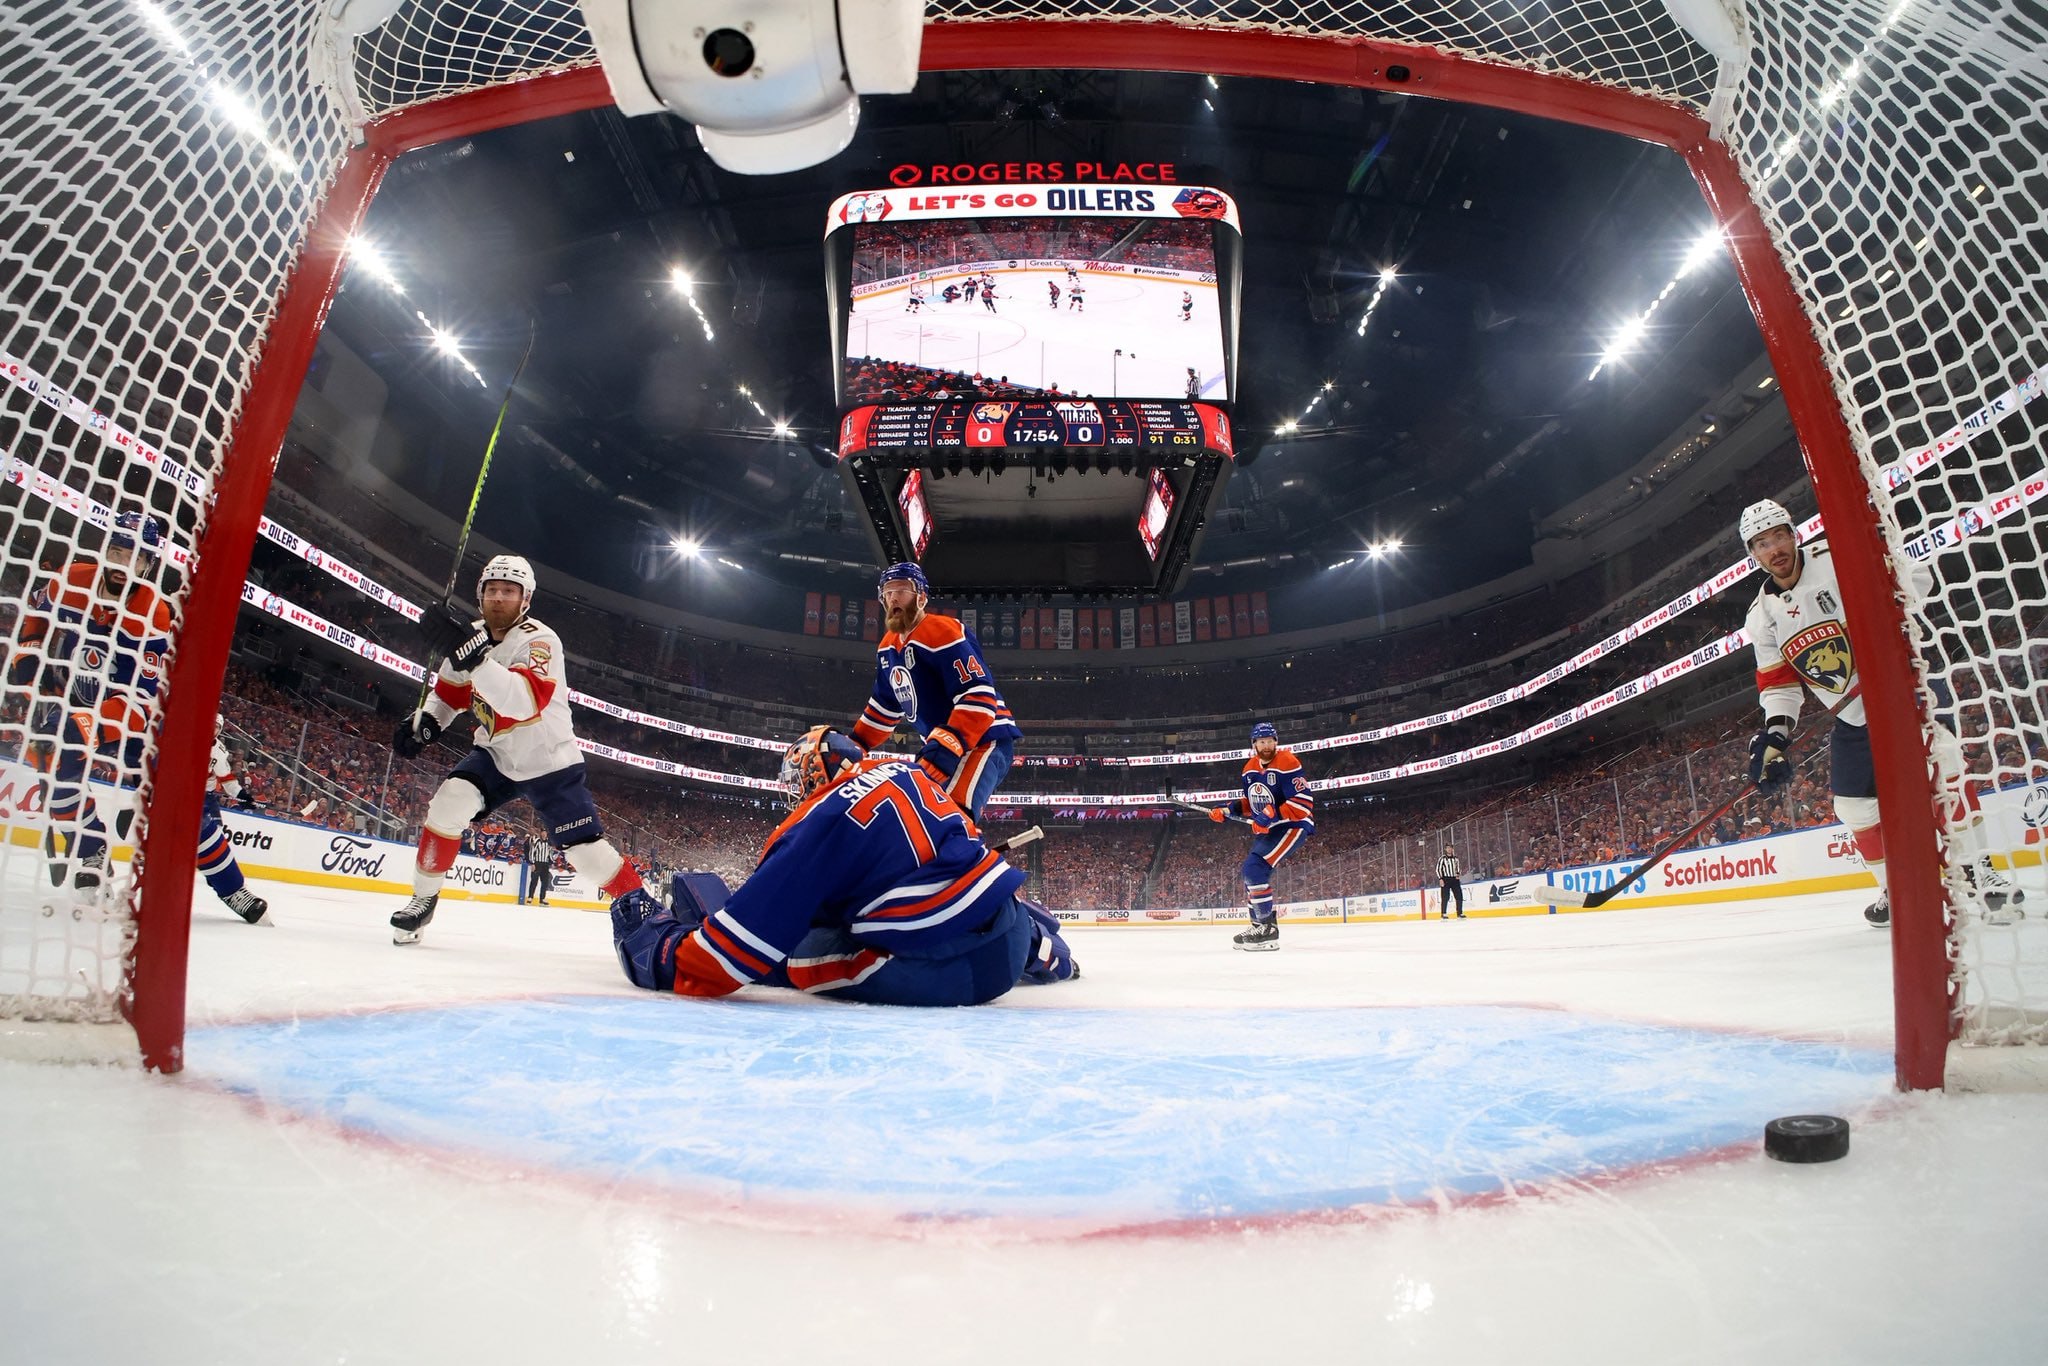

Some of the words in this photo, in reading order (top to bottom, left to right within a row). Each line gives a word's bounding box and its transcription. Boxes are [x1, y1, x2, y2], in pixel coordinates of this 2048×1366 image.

[932, 163, 1064, 182] ROGERS
[1076, 163, 1176, 180] PLACE
[909, 194, 986, 210] LET'S
[994, 194, 1037, 208] GO
[1047, 189, 1155, 212] OILERS
[1084, 262, 1124, 272] Molson
[1060, 410, 1098, 424] OILERS
[978, 428, 992, 442] 0
[1014, 430, 1059, 442] 17:54
[1078, 427, 1092, 442] 0
[1174, 436, 1196, 444] 0:31
[116, 432, 144, 455] LE'S
[2025, 481, 2044, 496] GO
[268, 524, 298, 550] OILERS
[328, 561, 347, 578] LET'S
[360, 578, 384, 600] OILERS
[1716, 572, 1735, 588] LET'S
[1642, 616, 1658, 629] LET'S
[1668, 594, 1692, 616] OILERS
[290, 610, 313, 626] LET'S
[314, 621, 326, 632] GO
[327, 626, 356, 648] OILERS
[1579, 652, 1592, 664] LET'S
[1600, 635, 1620, 654] OILERS
[1788, 626, 1836, 658] FLORIDA
[954, 655, 984, 684] 14
[1662, 665, 1680, 678] LET'S
[1692, 644, 1720, 666] OILERS
[382, 654, 400, 668] LET'S
[412, 664, 435, 686] OILES
[1546, 666, 1563, 682] OILERS
[1488, 694, 1507, 706] OILERS
[1591, 698, 1606, 710] LET'S
[1616, 683, 1638, 702] OILERS
[584, 697, 597, 708] LET'S
[605, 704, 622, 716] OILERS
[668, 721, 686, 734] OILERS
[1427, 714, 1448, 726] OILERS
[1534, 724, 1547, 736] LET'S
[1554, 712, 1572, 728] OILERS
[734, 736, 755, 746] OILERS
[1360, 731, 1380, 741] OILERS
[594, 744, 612, 757] OILERS
[1293, 743, 1313, 752] OILERS
[1476, 746, 1490, 756] LET'S
[1500, 736, 1518, 750] OILERS
[1222, 751, 1242, 759] OILERS
[1414, 762, 1430, 772] LET'S
[1440, 754, 1458, 767] OILERS
[630, 756, 646, 765] LET'S
[655, 760, 676, 773] OILERS
[722, 774, 744, 785] OILERS
[838, 764, 910, 804] SKINNER
[1371, 770, 1390, 782] OILERS
[1156, 794, 1178, 802] OILS
[555, 816, 592, 834] BAUER
[1832, 832, 1848, 841] THE
[321, 836, 386, 878] Ford
[1664, 848, 1778, 888] Scotiabank
[1564, 869, 1615, 894] PIZZA
[1328, 906, 1339, 916] NEWS
